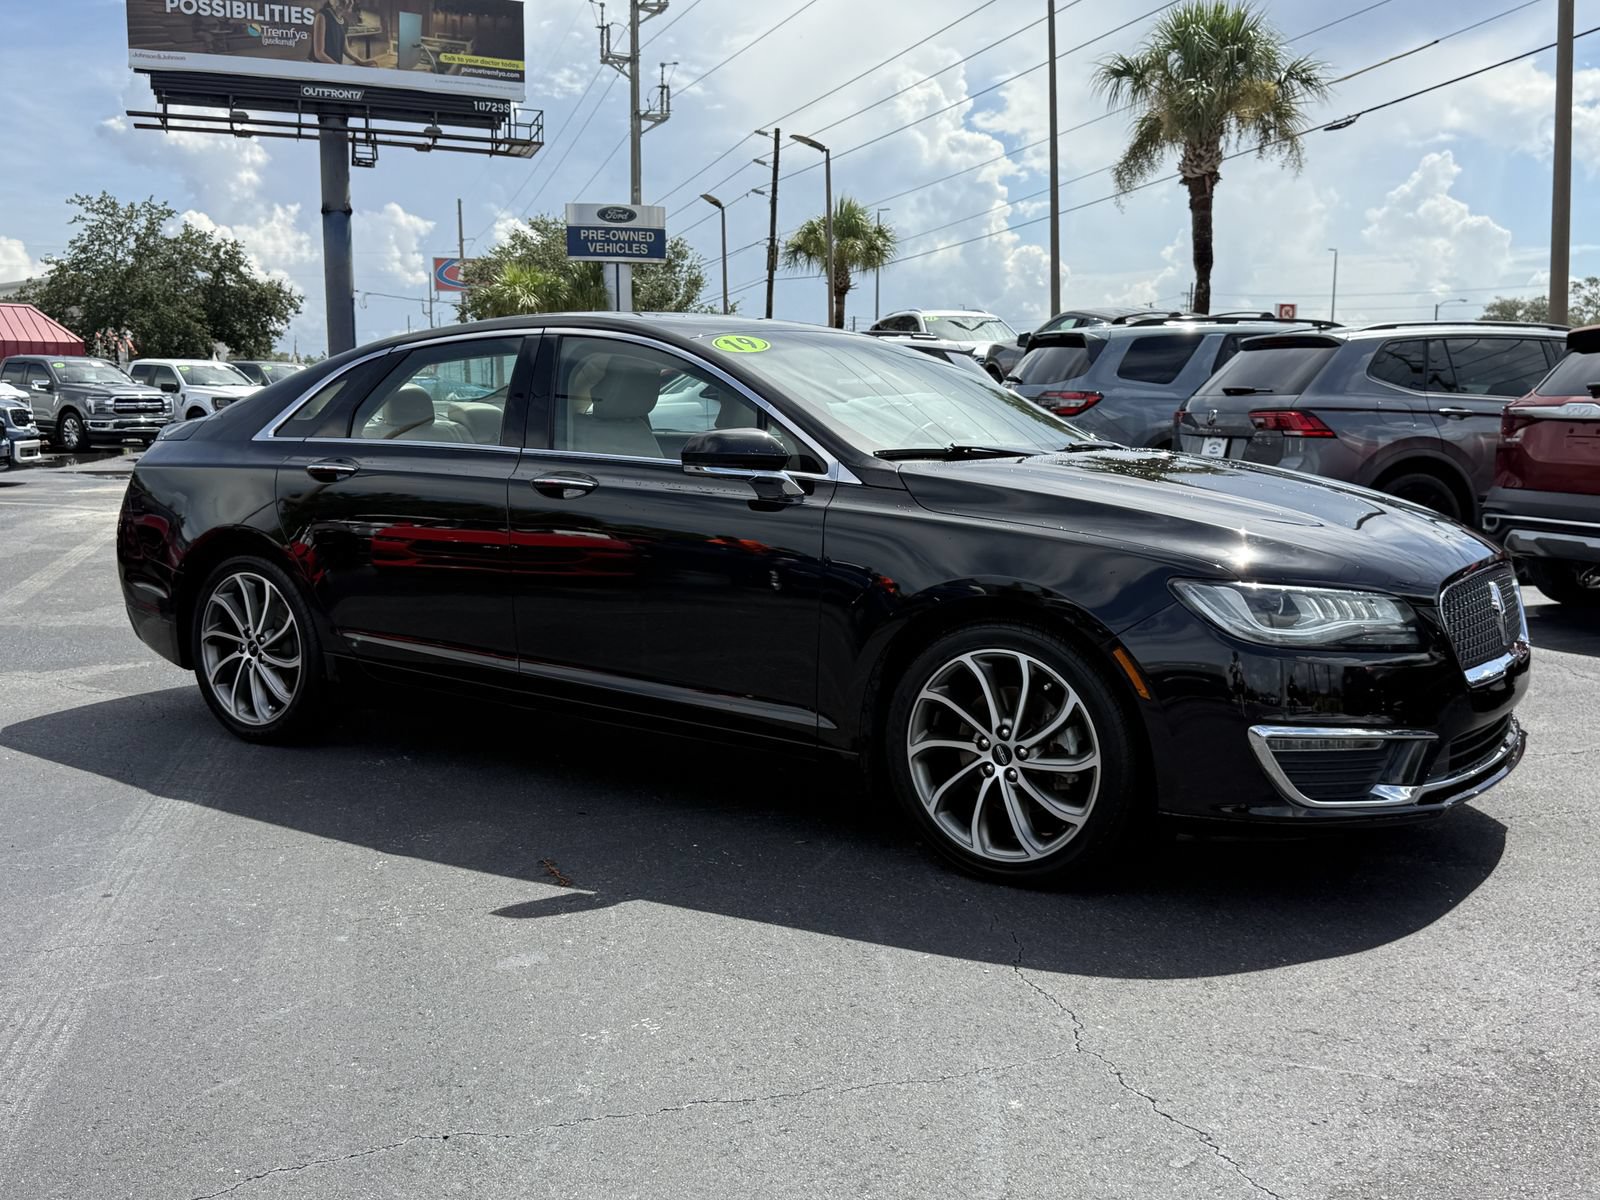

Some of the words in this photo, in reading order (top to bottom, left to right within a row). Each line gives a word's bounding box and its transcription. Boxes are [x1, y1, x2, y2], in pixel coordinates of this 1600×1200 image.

[166, 0, 315, 25] POSSIBILITIES
[261, 25, 308, 41] Tremfya
[480, 57, 500, 67] doctor
[461, 66, 520, 79] pursuetremfya.com
[605, 209, 629, 220] Ford
[580, 229, 655, 242] PRE-OWNED
[587, 242, 649, 255] VEHICLES
[722, 337, 757, 351] 19
